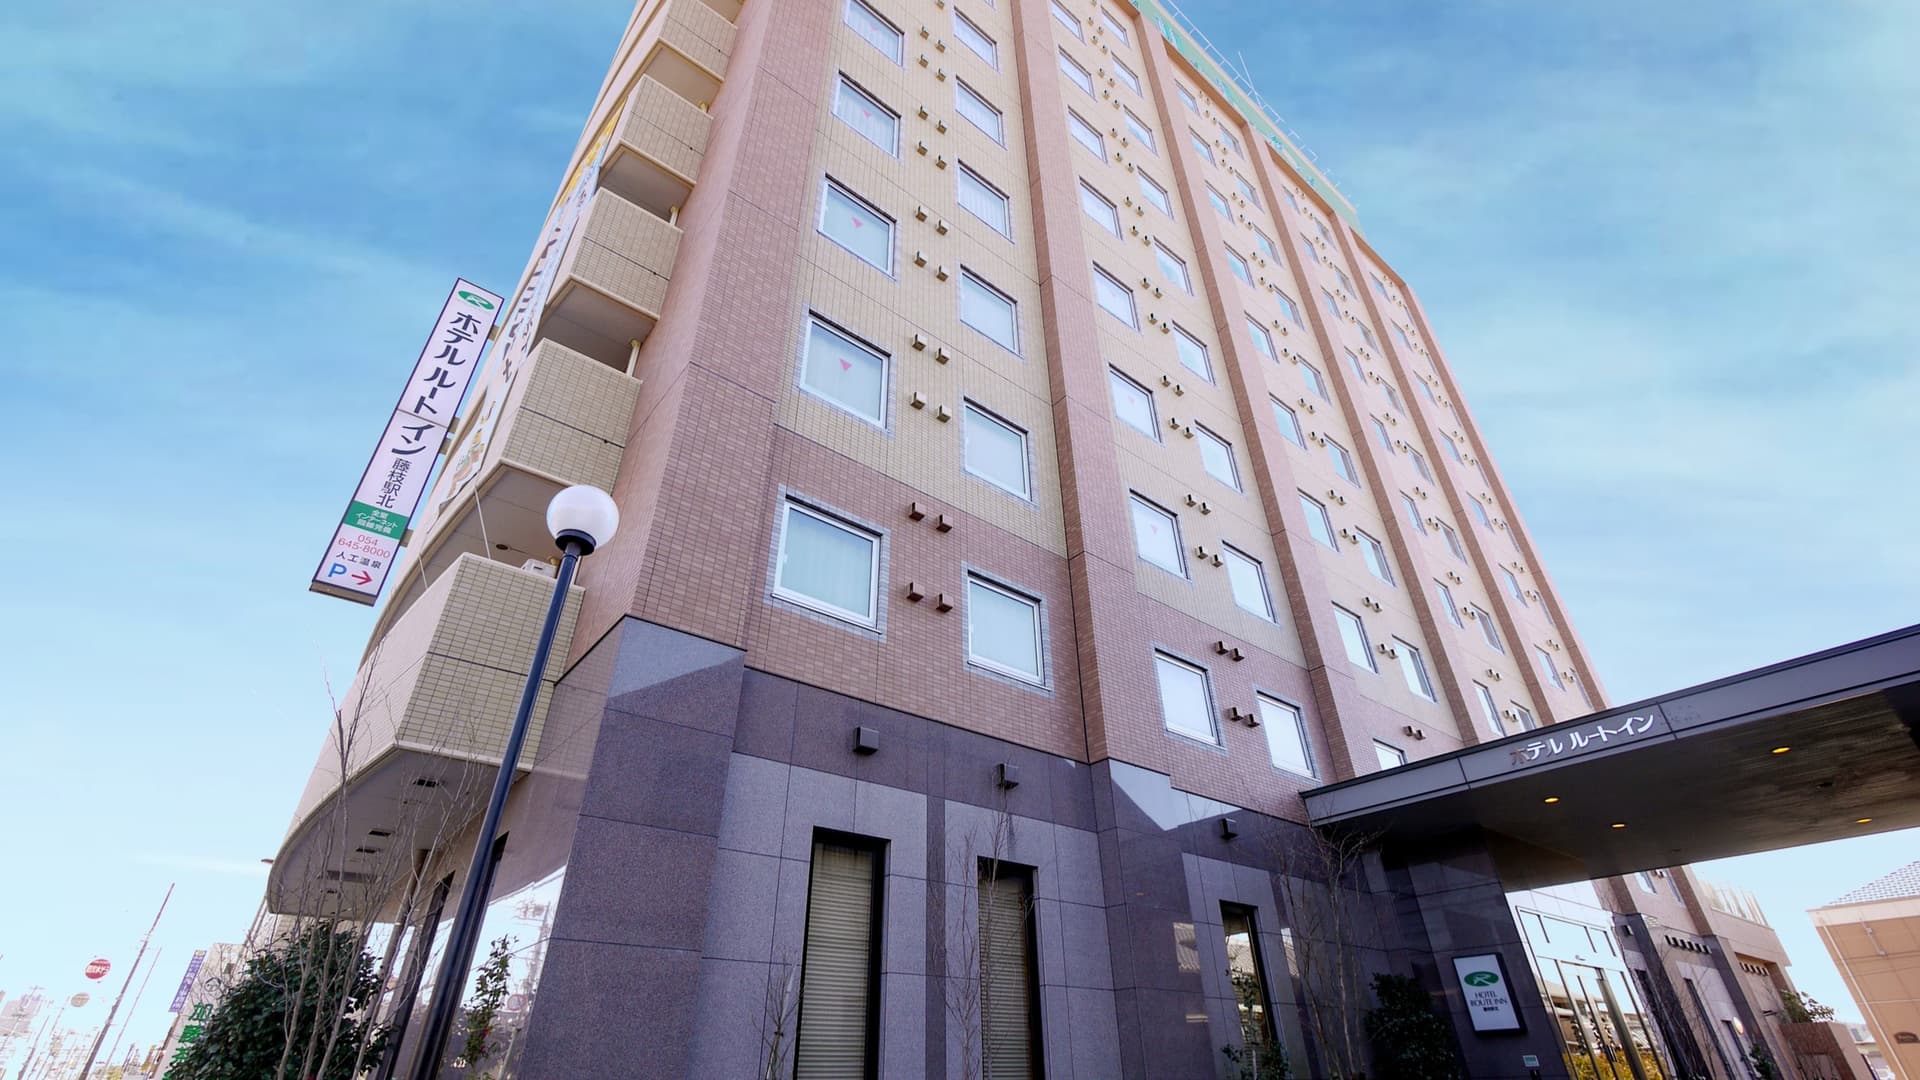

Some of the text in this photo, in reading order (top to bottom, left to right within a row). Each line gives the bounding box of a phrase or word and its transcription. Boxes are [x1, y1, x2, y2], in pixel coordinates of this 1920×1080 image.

[392, 312, 481, 455] ホテルルートイン
[376, 457, 412, 509] 藤枝駅北
[338, 538, 391, 559] 645-8000
[357, 534, 378, 546] 054
[336, 551, 382, 569] 人工温泉
[327, 562, 347, 577] P
[1474, 991, 1497, 999] HOTEL
